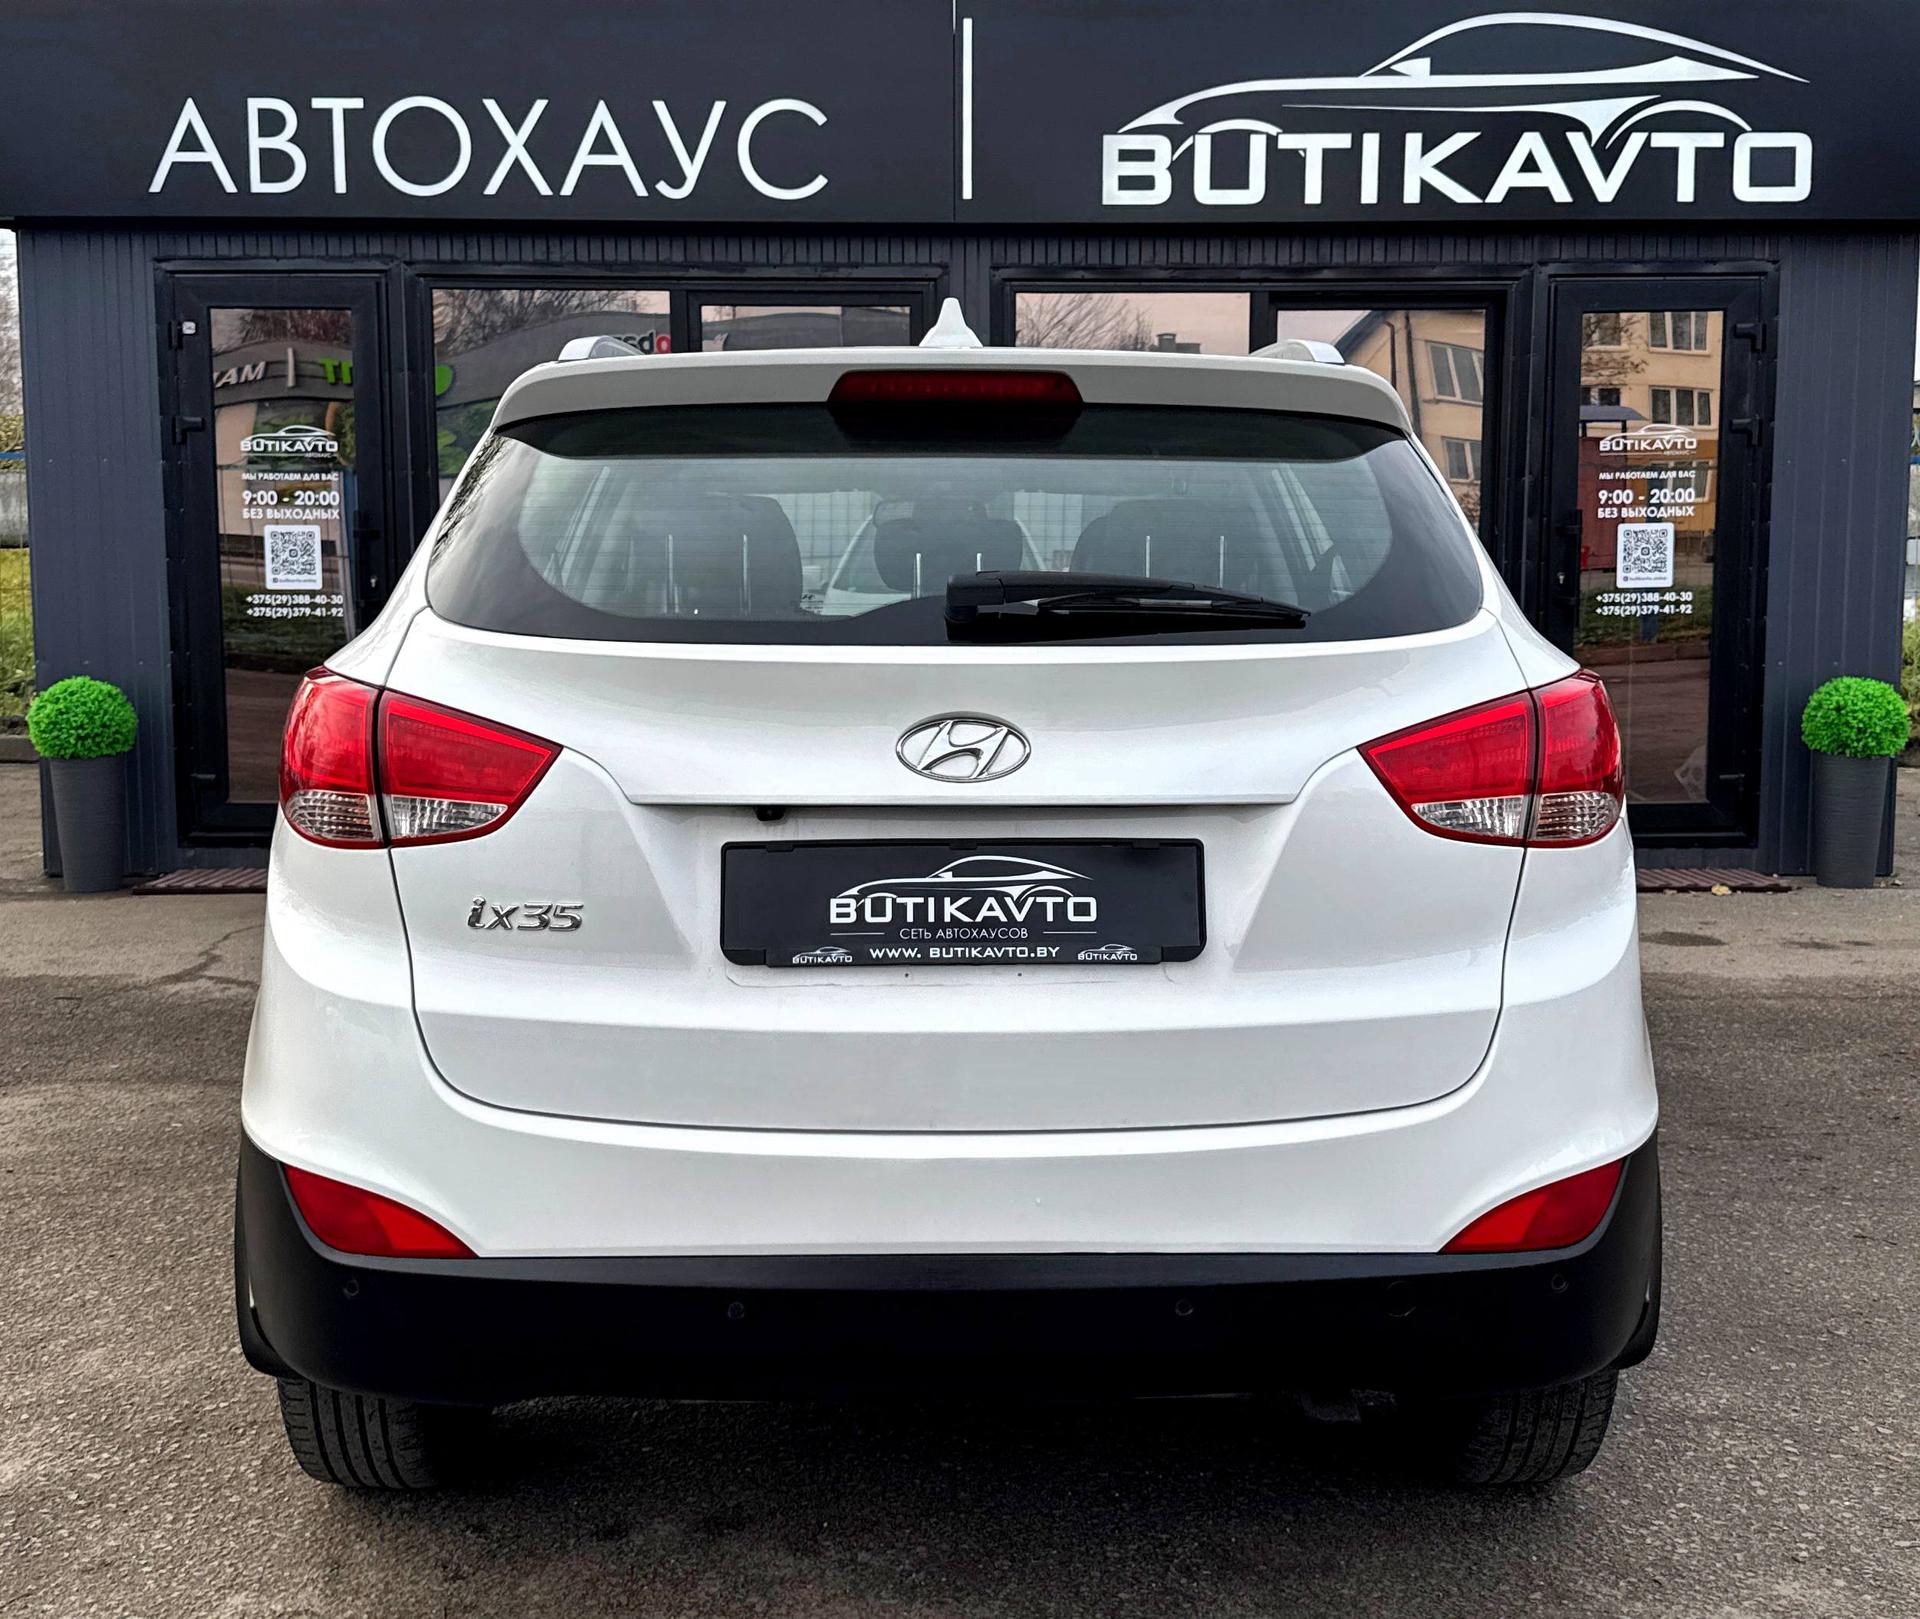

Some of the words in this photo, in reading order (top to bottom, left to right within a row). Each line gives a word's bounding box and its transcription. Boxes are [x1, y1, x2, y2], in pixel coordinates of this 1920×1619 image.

[148, 95, 829, 200] АВТОХАУС
[1102, 132, 1813, 205] BUTIKAVTO
[240, 440, 339, 453] BUTIKAVTO
[1599, 438, 1698, 452] BUTIKAVTO
[242, 473, 257, 481] МЫ
[258, 473, 301, 481] РАБОТАЕМ
[303, 473, 320, 481] ДЛЯ
[321, 473, 339, 481] ВАС
[1599, 472, 1614, 480] МЫ
[1615, 471, 1658, 480] РАБОТАЕМ
[1659, 471, 1677, 479] ДЛЯ
[1678, 470, 1696, 478] ВАС
[242, 490, 278, 506] 9:00
[294, 490, 340, 506] 20:00
[1598, 489, 1634, 505] 9:00
[1649, 488, 1696, 504] 20:00
[242, 508, 263, 520] БЕЗ
[266, 508, 340, 520] ВЫХОДНЫХ
[1597, 507, 1618, 519] БЕЗ
[1621, 506, 1695, 519] ВЫХОДНЫХ
[245, 594, 344, 606] +375(29)388-40-30
[1595, 591, 1693, 604] +375(29)388-40-30
[246, 607, 344, 619] +375(29)379-41-92
[1595, 604, 1693, 617] +375(29)379-41-92
[467, 896, 584, 931] ix35
[829, 896, 1097, 924] BUTIKAVTO
[899, 927, 931, 940] СЕТЬ
[935, 926, 1029, 940] АВТОХАУСОВ
[869, 946, 921, 959] WWW.
[929, 945, 1060, 959] BUTIKAVTO.BY
[1077, 952, 1138, 962] BUTIKAVTO
[792, 954, 853, 965] BUTIKAVTO
